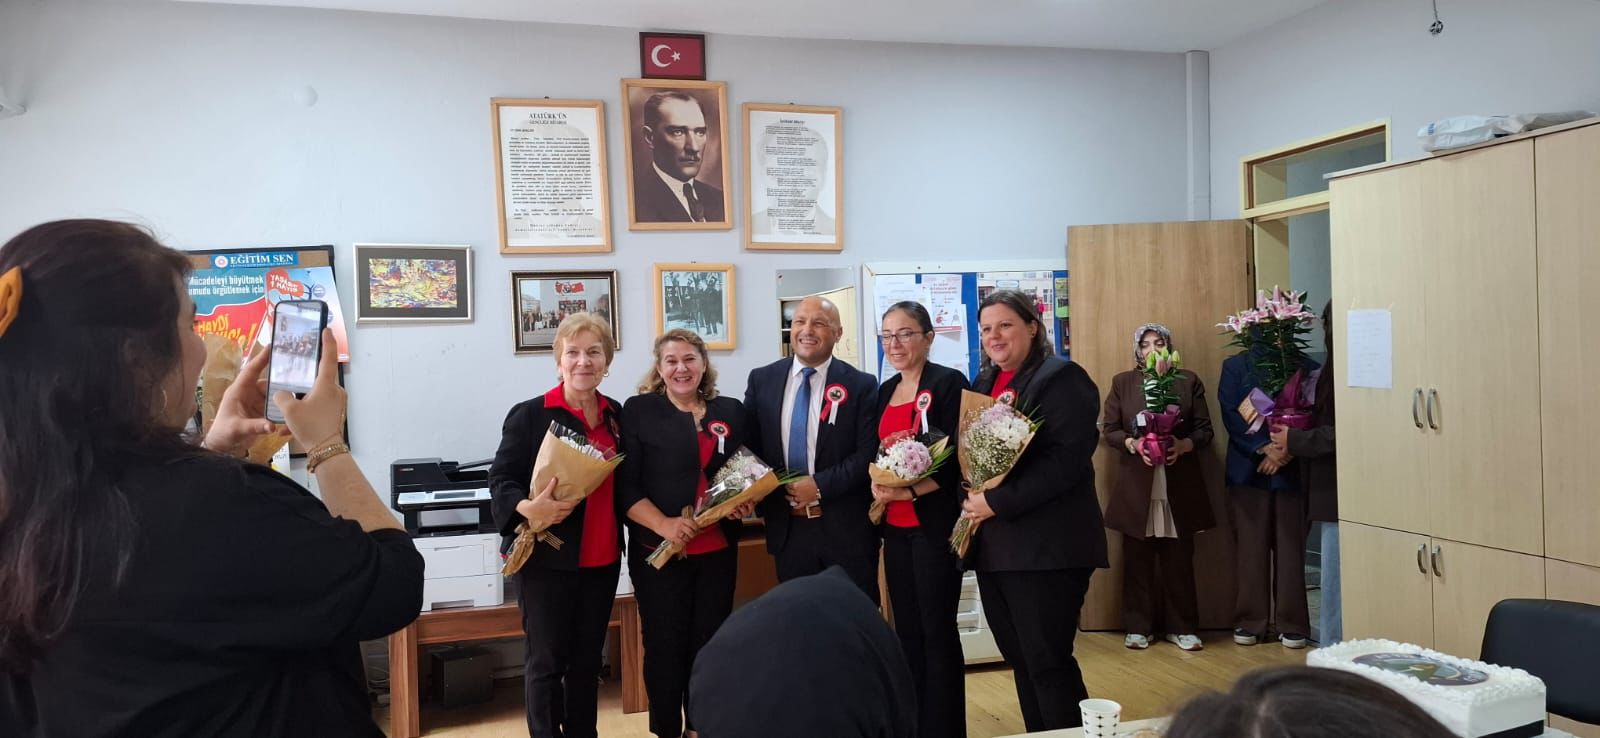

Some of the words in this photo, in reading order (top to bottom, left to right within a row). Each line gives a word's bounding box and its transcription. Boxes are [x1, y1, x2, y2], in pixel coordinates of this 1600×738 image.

[230, 254, 269, 264] EĞİTİM
[272, 254, 294, 263] SEN
[229, 274, 264, 286] büyütmek
[213, 285, 250, 296] örgütlemek
[252, 284, 264, 295] için
